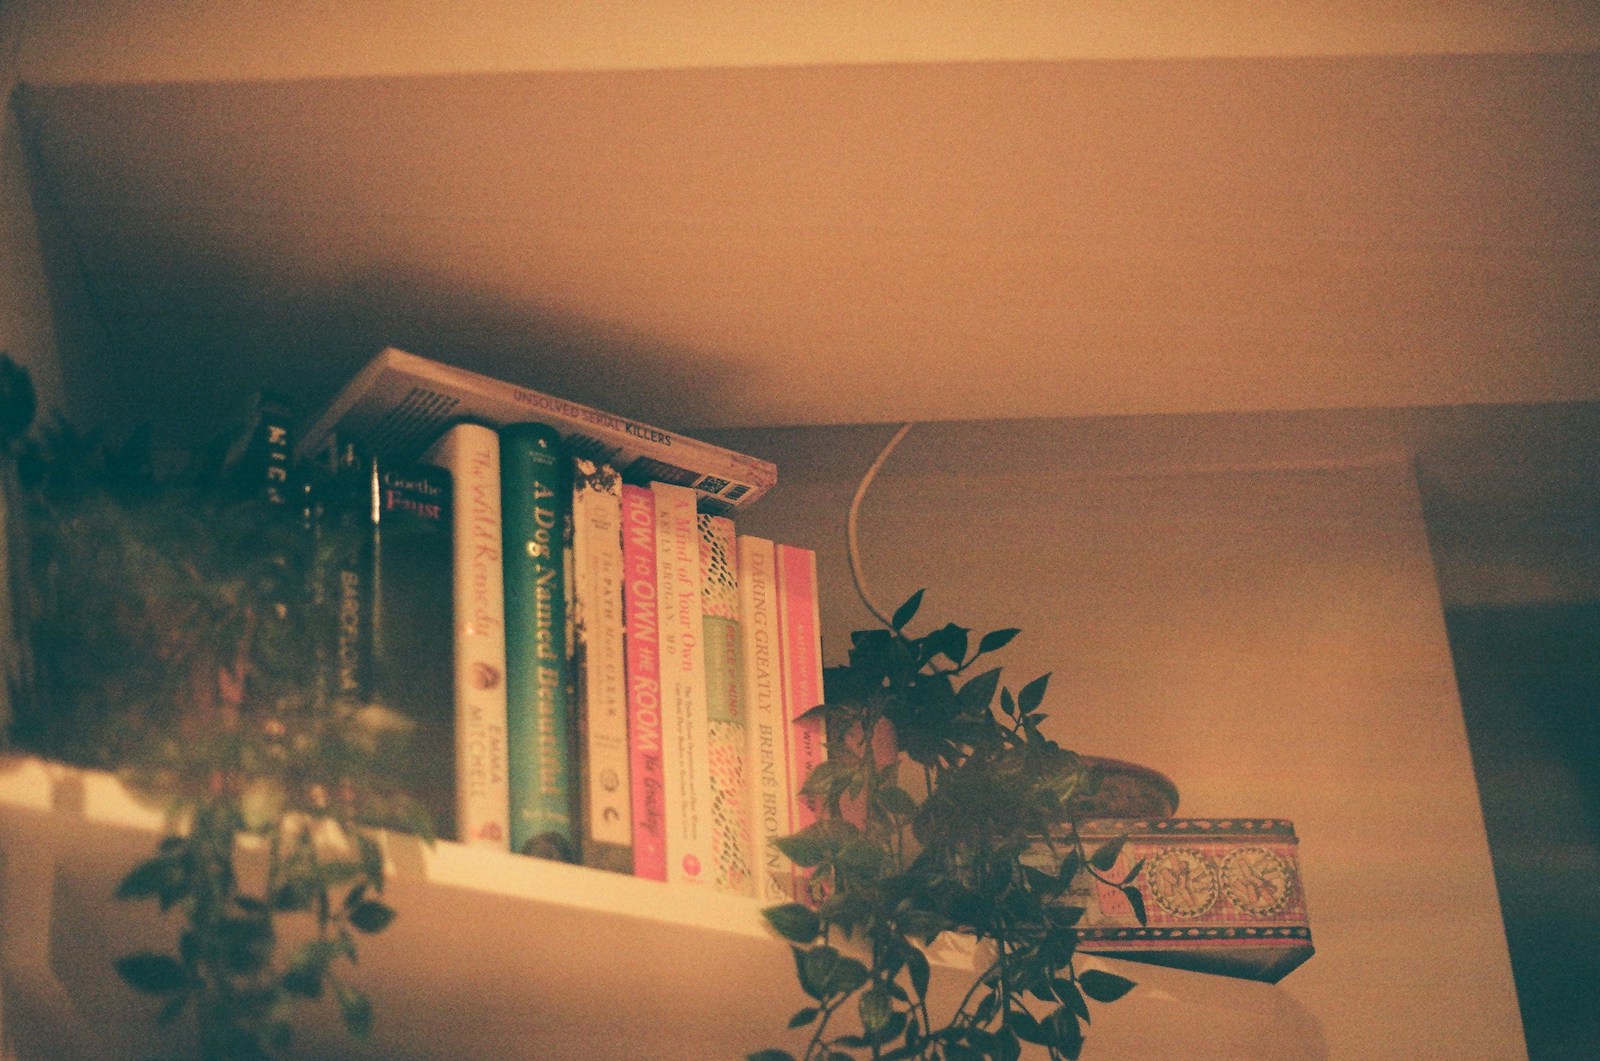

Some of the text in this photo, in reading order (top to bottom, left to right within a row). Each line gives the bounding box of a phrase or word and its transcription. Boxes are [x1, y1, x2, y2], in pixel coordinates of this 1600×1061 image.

[512, 388, 673, 447] UNSOLVED SERIAL KILLERS
[534, 479, 554, 499] A
[525, 505, 556, 560] Dog
[630, 494, 654, 550] HOW
[660, 510, 674, 555] KELLY
[535, 563, 560, 660] Named
[631, 579, 657, 643] OWN
[675, 497, 696, 673] A Mind of Your Own
[666, 633, 676, 655] MD
[751, 551, 772, 713] DARING GREATLY
[537, 666, 561, 795] Beautiful
[633, 675, 659, 752] ROOM
[803, 730, 813, 756] WHY
[758, 723, 782, 867] BRENÉ BROWN
